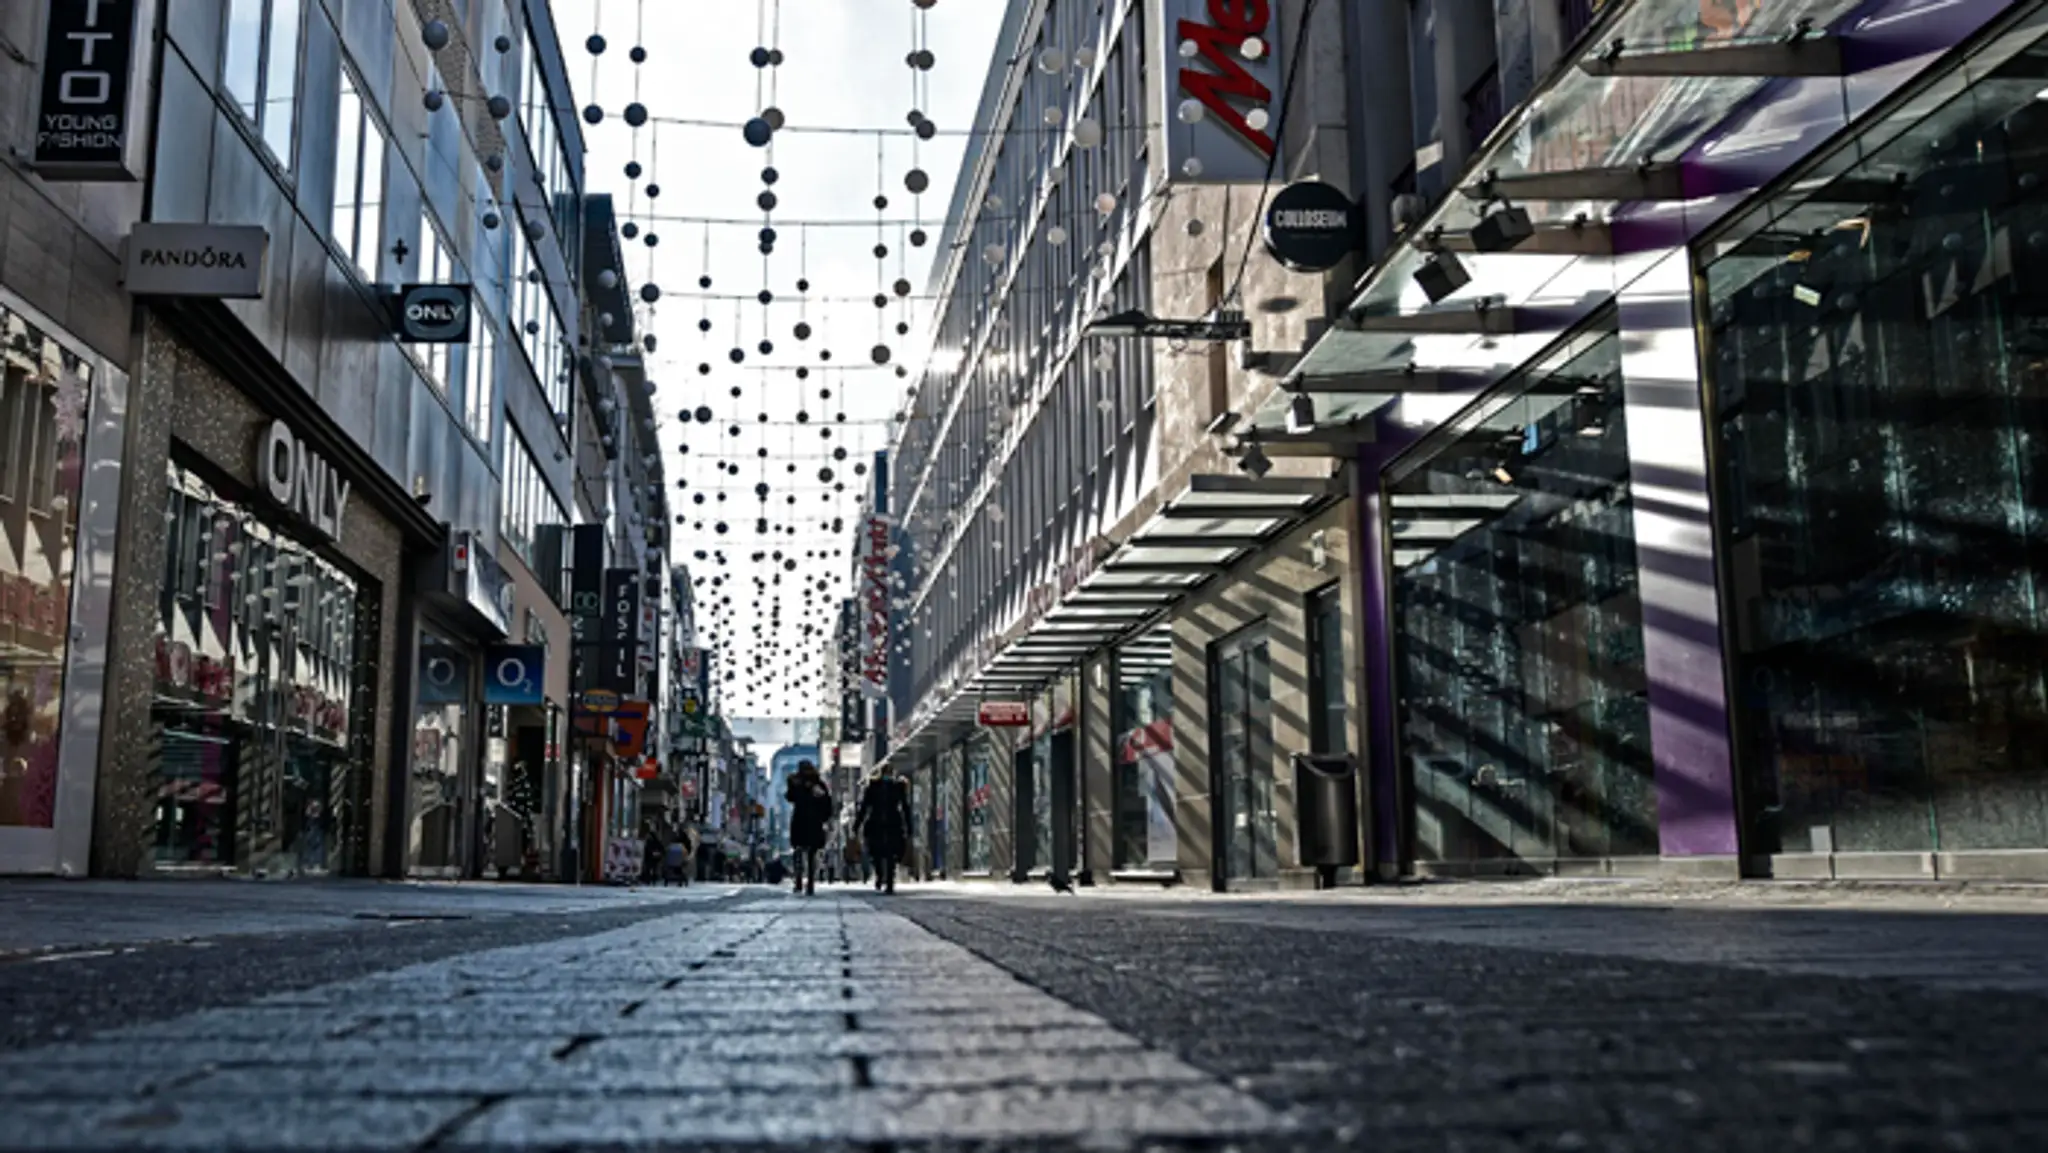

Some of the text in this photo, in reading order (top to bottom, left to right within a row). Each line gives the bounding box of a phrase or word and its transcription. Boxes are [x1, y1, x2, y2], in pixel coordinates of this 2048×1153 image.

[45, 114, 117, 130] YOUNG
[37, 131, 124, 148] FASHION
[406, 304, 465, 321] ONLY
[262, 418, 350, 543] ONLY
